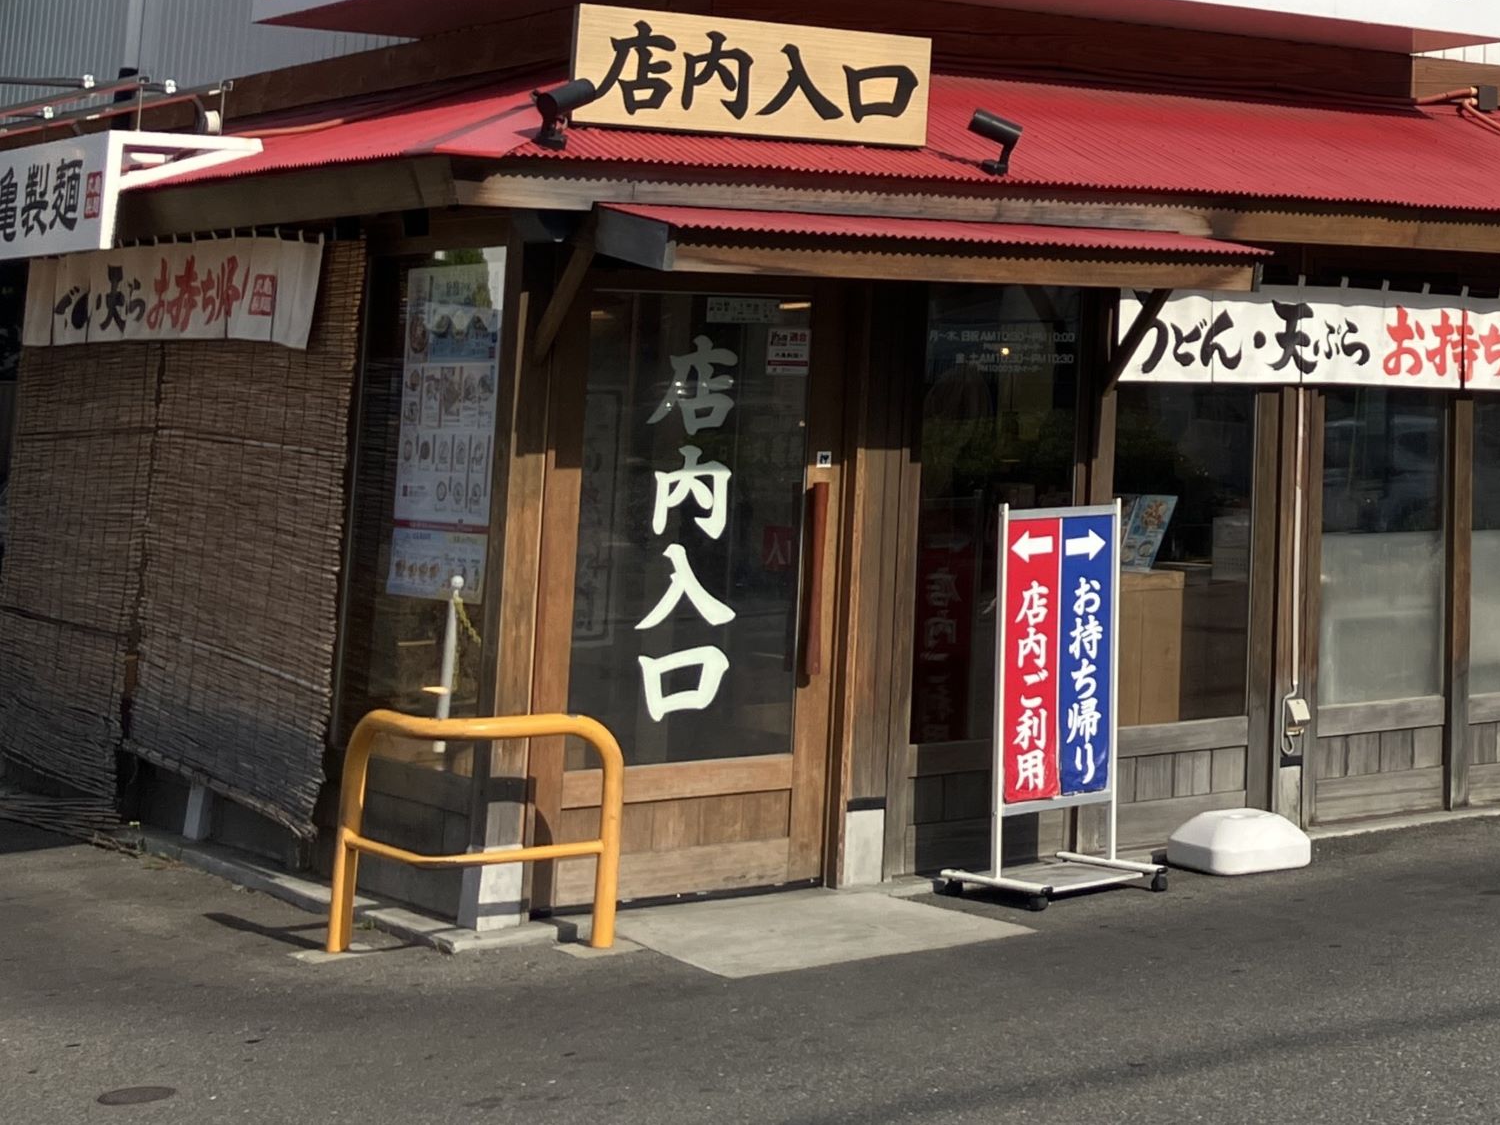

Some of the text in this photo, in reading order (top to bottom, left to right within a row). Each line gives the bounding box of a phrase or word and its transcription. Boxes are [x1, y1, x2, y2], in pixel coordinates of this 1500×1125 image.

[595, 20, 919, 124] 店内入口
[634, 333, 739, 723] 店内入口
[1012, 580, 1050, 792] 店内ご利用
[1066, 576, 1104, 785] お持ち帰り
